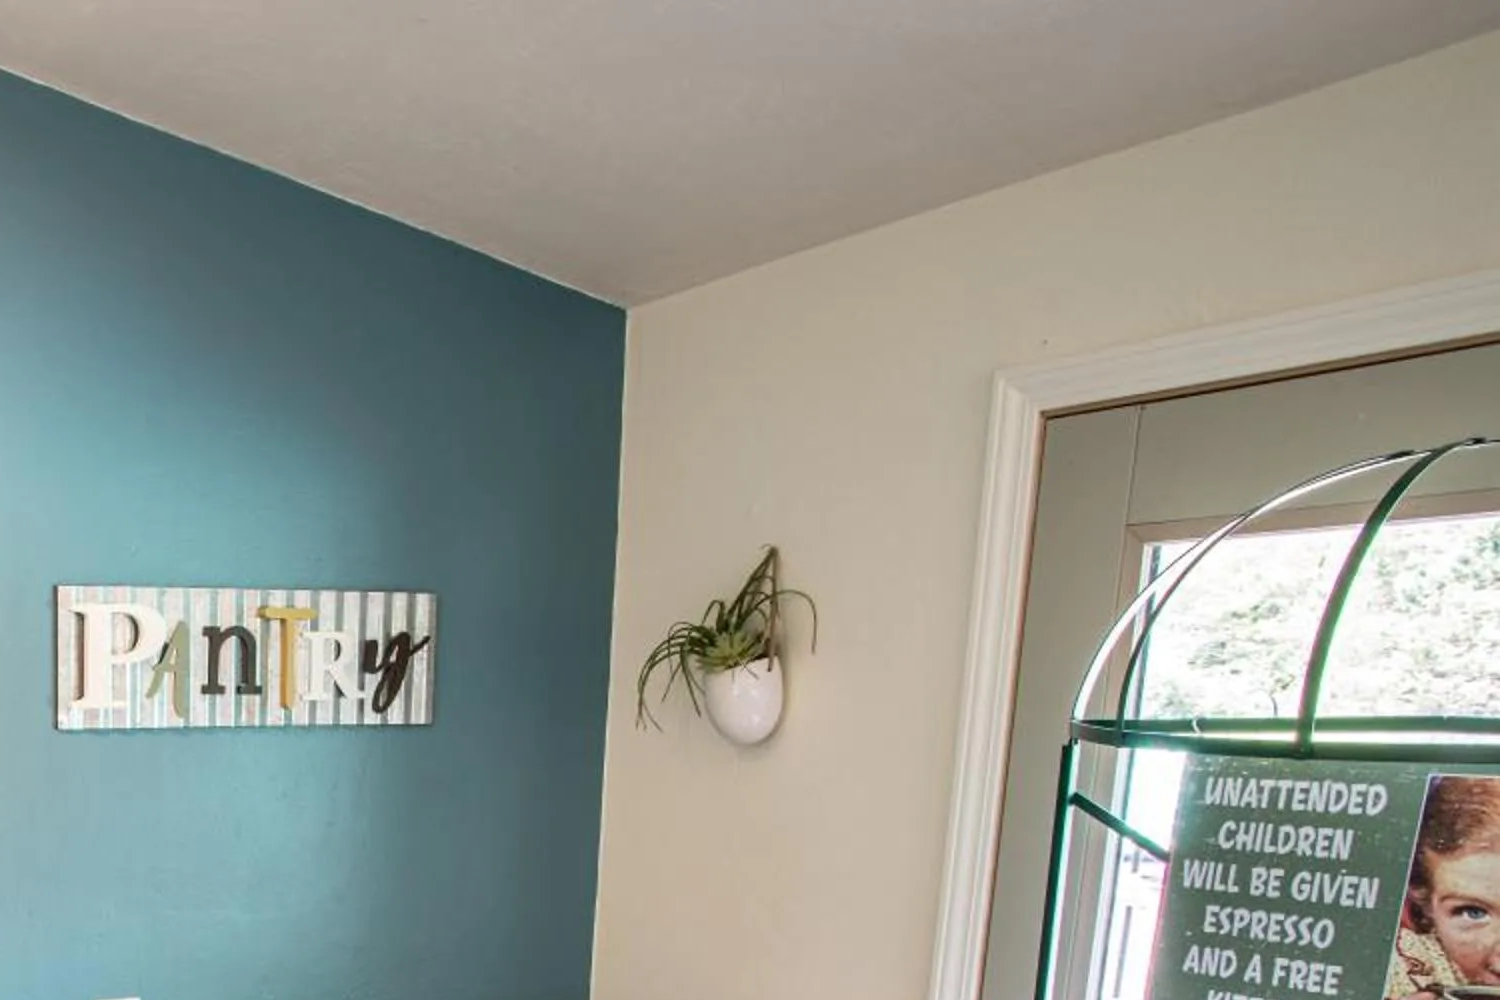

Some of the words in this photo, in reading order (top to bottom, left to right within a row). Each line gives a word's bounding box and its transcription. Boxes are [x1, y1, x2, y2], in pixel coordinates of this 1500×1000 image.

[1205, 777, 1388, 816] UNATTENDED
[1217, 820, 1355, 860] CHILDREN
[1183, 859, 1240, 893] WILL
[1249, 866, 1285, 899] BE
[1290, 871, 1380, 909] GIVEN
[1203, 905, 1335, 949] ESPRESSO
[1182, 945, 1237, 980] AND
[1243, 954, 1262, 984] A
[1272, 957, 1343, 995] FREE
